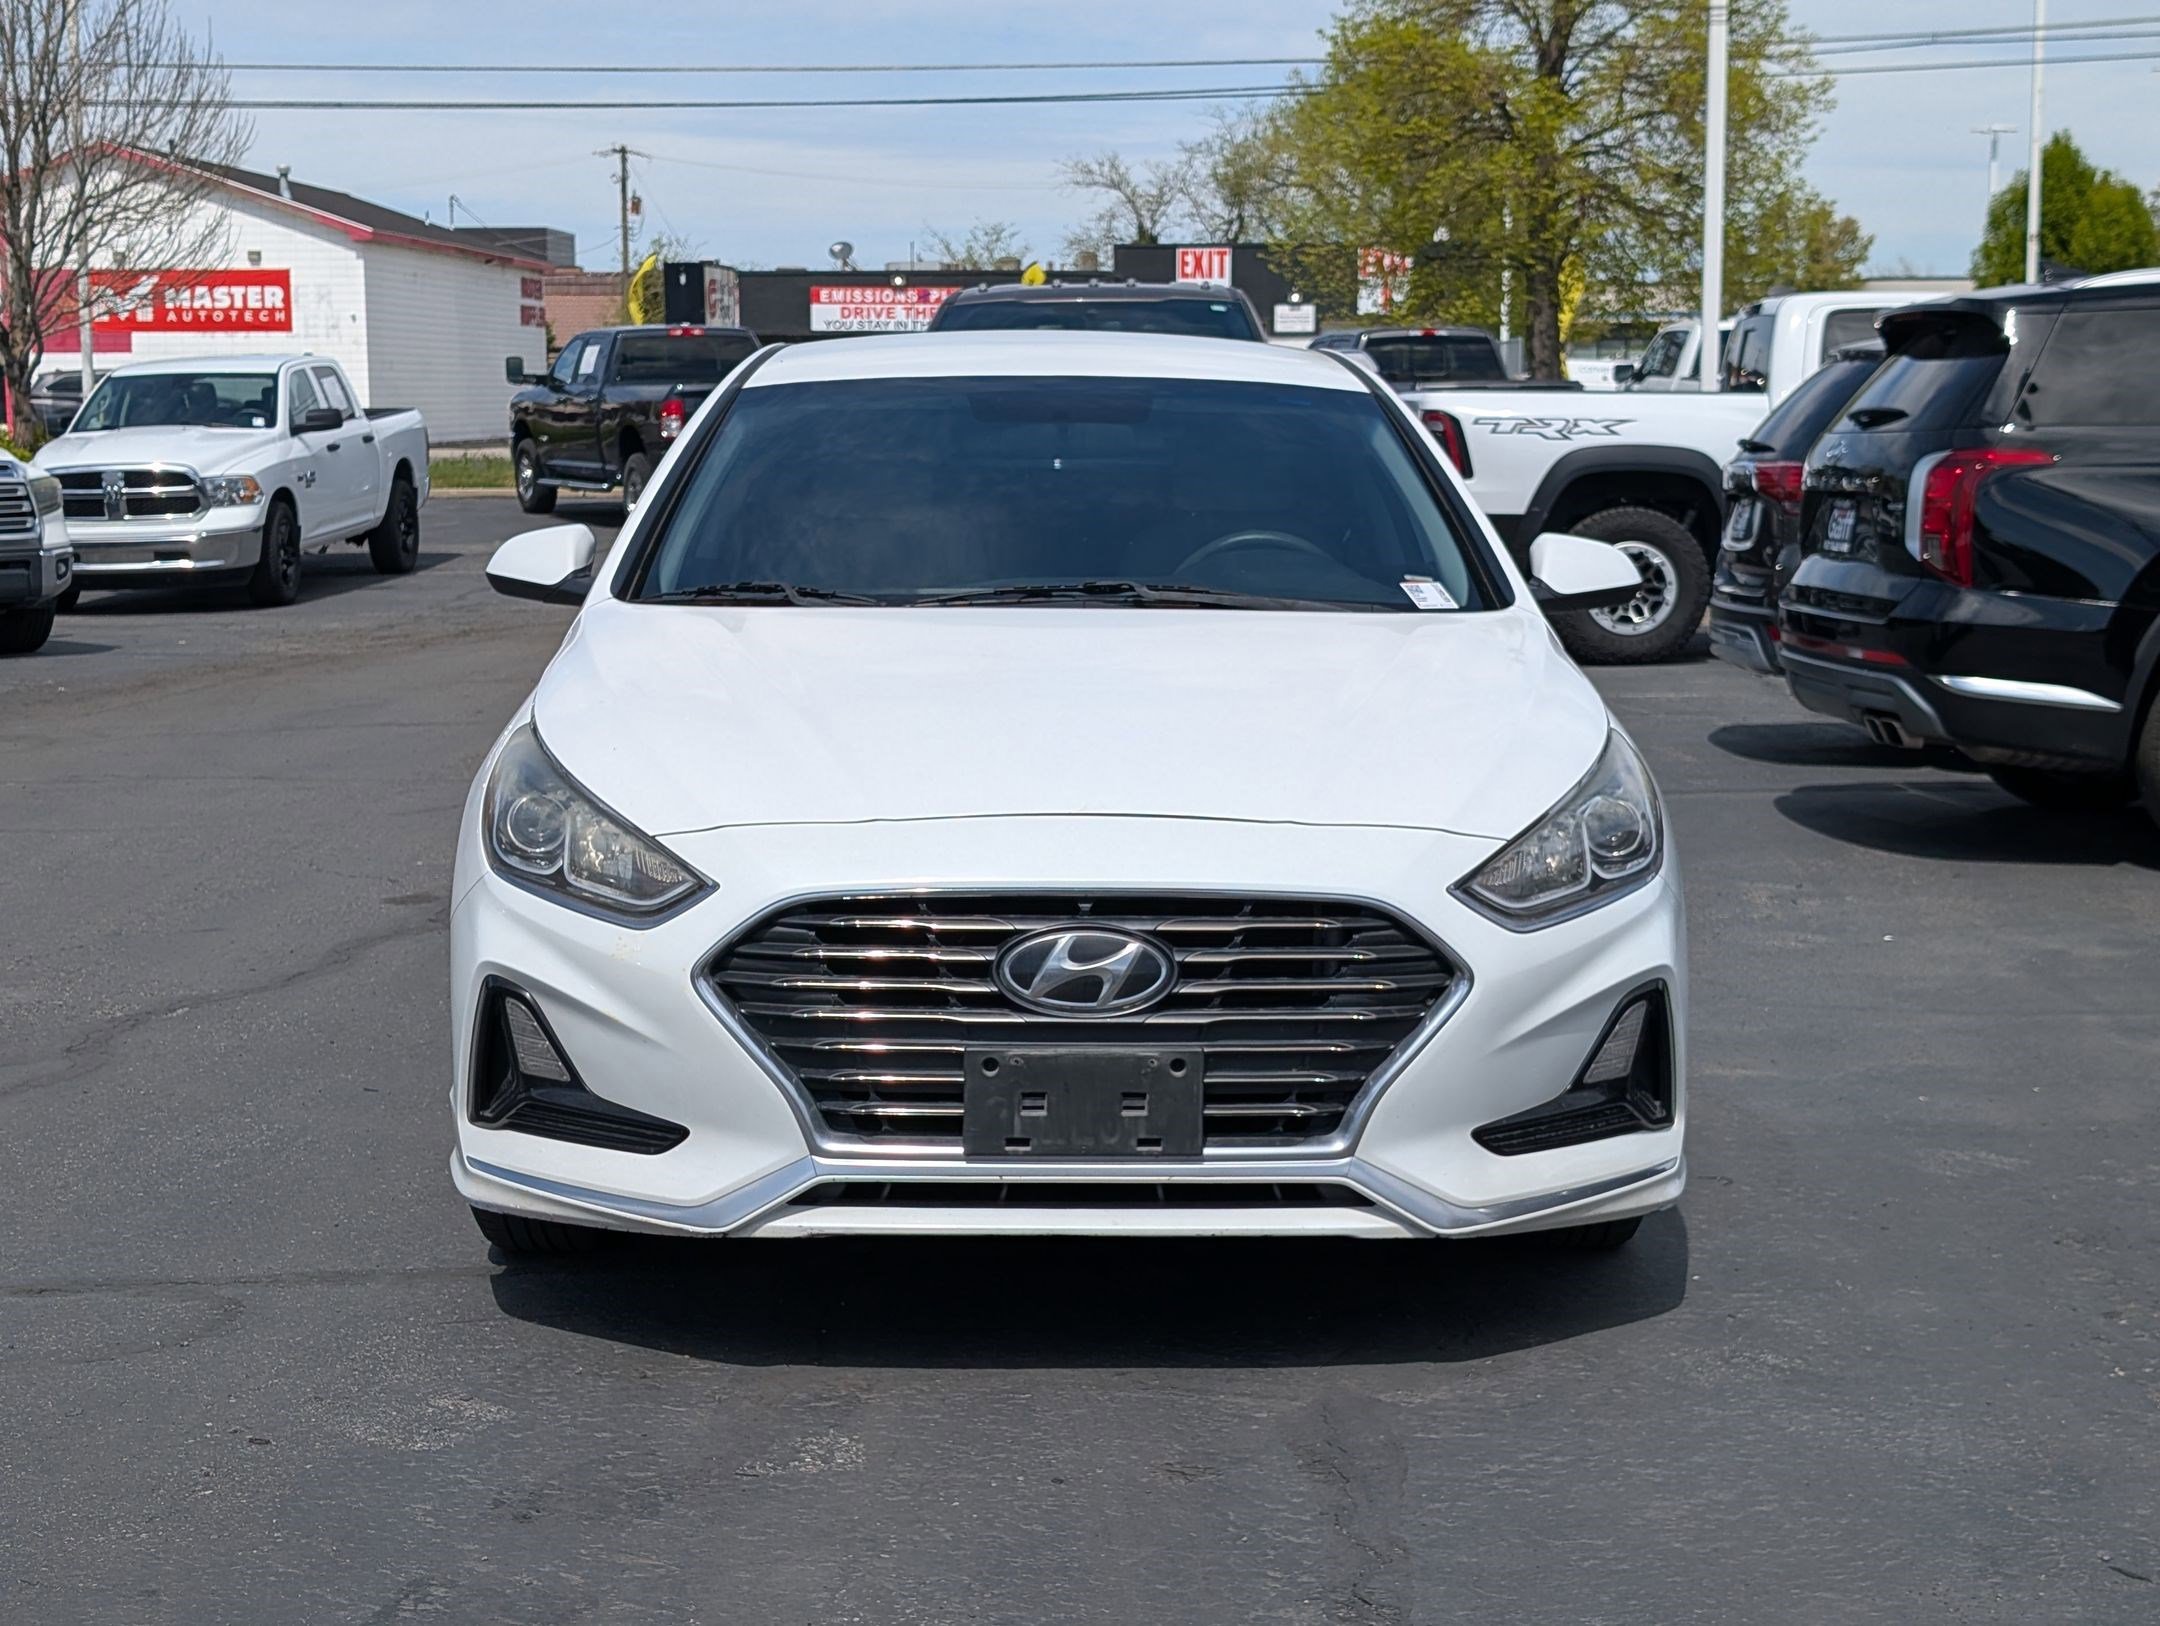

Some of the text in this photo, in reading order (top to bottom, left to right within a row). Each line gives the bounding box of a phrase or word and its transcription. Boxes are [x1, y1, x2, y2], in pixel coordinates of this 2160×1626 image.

[1180, 250, 1228, 280] EXIT
[165, 285, 284, 309] MASTER
[819, 287, 919, 303] EMISSIONS
[166, 310, 286, 323] AUTOTECH
[840, 306, 896, 320] DRIVE
[824, 319, 854, 331] YOU
[857, 319, 890, 331] STAY
[894, 319, 908, 331] IN
[1472, 417, 1638, 441] TRX
